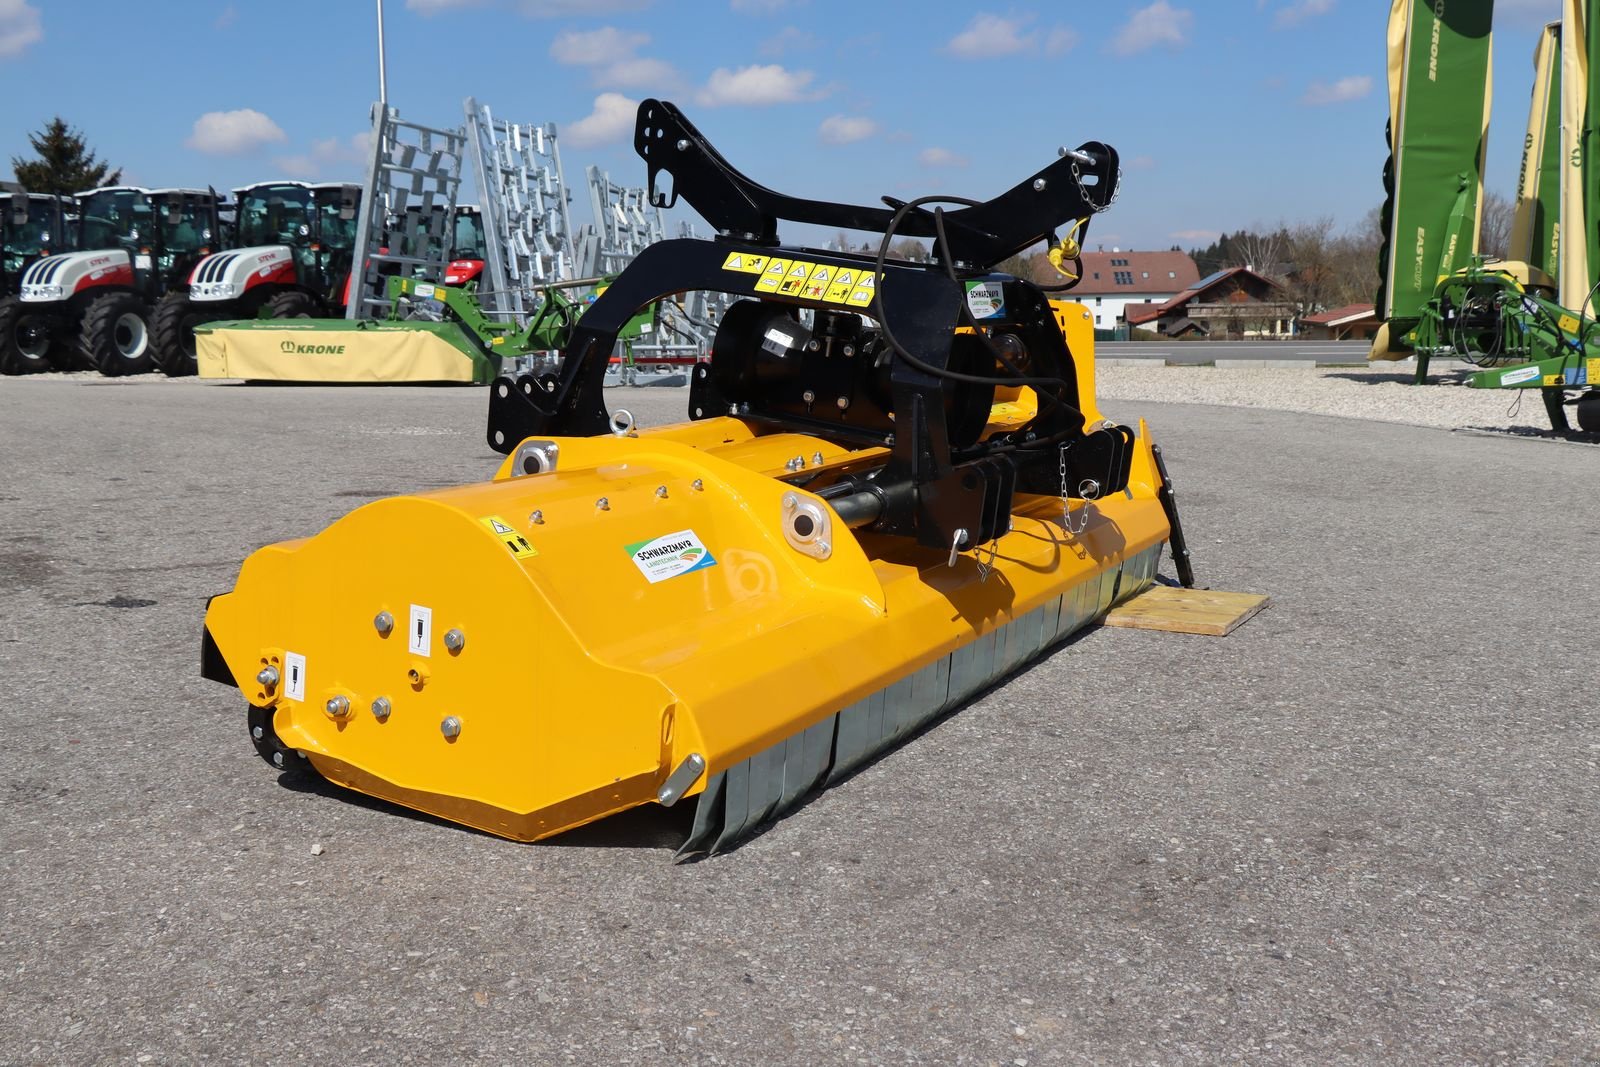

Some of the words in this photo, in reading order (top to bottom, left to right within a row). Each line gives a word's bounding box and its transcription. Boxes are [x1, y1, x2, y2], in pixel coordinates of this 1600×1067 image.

[1428, 17, 1441, 82] KRONE
[296, 345, 345, 355] KRONE
[637, 539, 693, 561] SCHWARZMAYR
[646, 555, 679, 569] LANDTECHNIK
